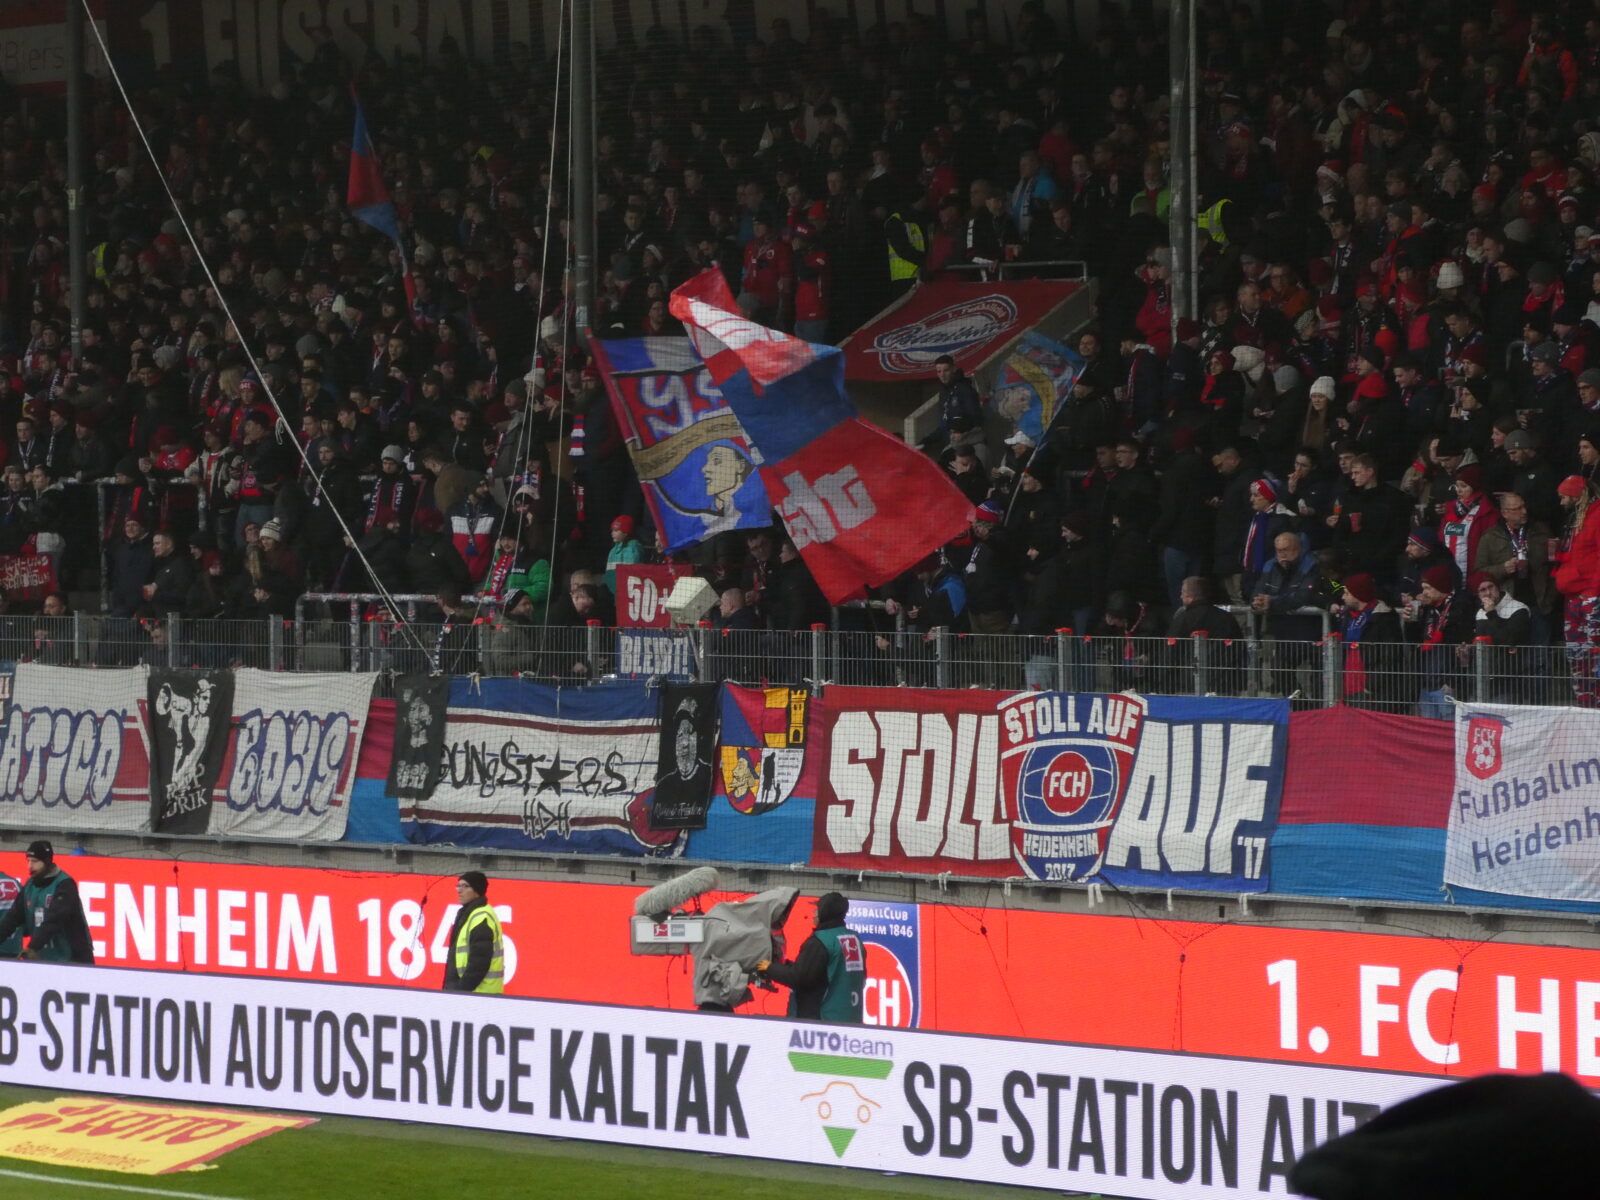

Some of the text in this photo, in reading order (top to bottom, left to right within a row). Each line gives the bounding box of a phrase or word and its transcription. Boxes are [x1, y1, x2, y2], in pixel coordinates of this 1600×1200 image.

[1004, 695, 1140, 744] STOLL AUF
[826, 711, 1011, 860] STOLL
[1105, 721, 1274, 875] AUF
[1048, 771, 1087, 798] FCH
[1023, 832, 1100, 858] HEIDENHEIM
[1045, 863, 1076, 881] 2017
[78, 882, 337, 974] ENHEIM
[889, 924, 913, 938] 1846
[863, 978, 899, 1027] CH
[1267, 960, 1329, 1053] 1.
[1360, 965, 1460, 1064] FC
[225, 1004, 534, 1115] AUTOSERVICE
[549, 1028, 750, 1139] KALTAK
[903, 1061, 1238, 1189] SB-STATION
